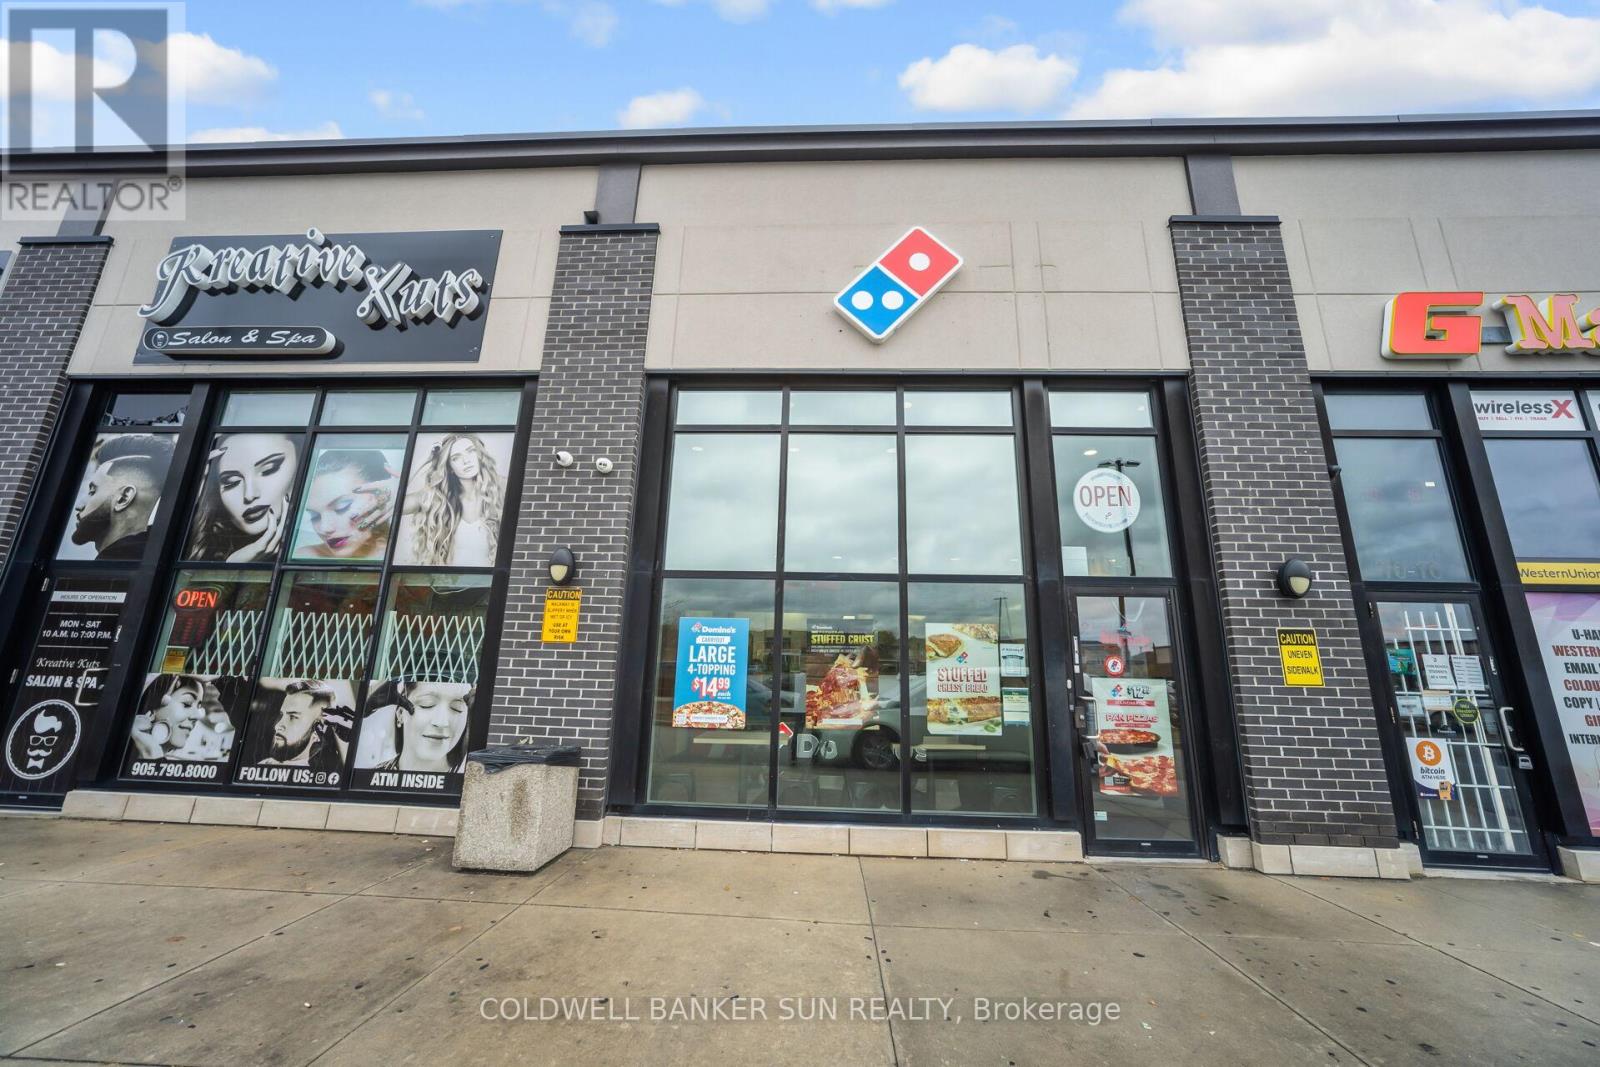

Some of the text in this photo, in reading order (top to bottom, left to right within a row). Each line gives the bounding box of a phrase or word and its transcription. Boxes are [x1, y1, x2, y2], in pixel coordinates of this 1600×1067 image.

[137, 227, 368, 320] Kreative
[356, 263, 484, 329] Kuts
[168, 328, 317, 348] Salon & Spa
[1474, 399, 1573, 419] wirelessX
[1079, 486, 1132, 507] OPEN
[176, 590, 218, 608] OPEN
[547, 590, 581, 599] CAUTION
[60, 620, 80, 628] MON
[86, 621, 102, 629] SAT
[43, 630, 51, 638] 10
[52, 630, 69, 638] A.M.
[80, 631, 96, 639] 7:00
[811, 634, 875, 645] STUFFED CRUST
[1280, 633, 1315, 645] CAUTION
[689, 645, 736, 663] LARGE
[1287, 650, 1313, 659] UNEVEN
[36, 657, 101, 669] Kreative Kuts
[687, 663, 736, 676] 4-TOPPING
[1564, 662, 1598, 674] EMAIL
[937, 666, 988, 683] STUFFED
[1286, 665, 1319, 675] SIDEWALK
[25, 675, 64, 687] SALON
[64, 676, 73, 688] &
[1563, 696, 1593, 709] COPY
[1106, 713, 1159, 723] PAN PIZZAS
[131, 762, 217, 779] 905.790.8000
[238, 767, 314, 786] FOLLOW US:
[1420, 767, 1446, 775] bitcoin
[370, 772, 445, 789] ATM INSIDE
